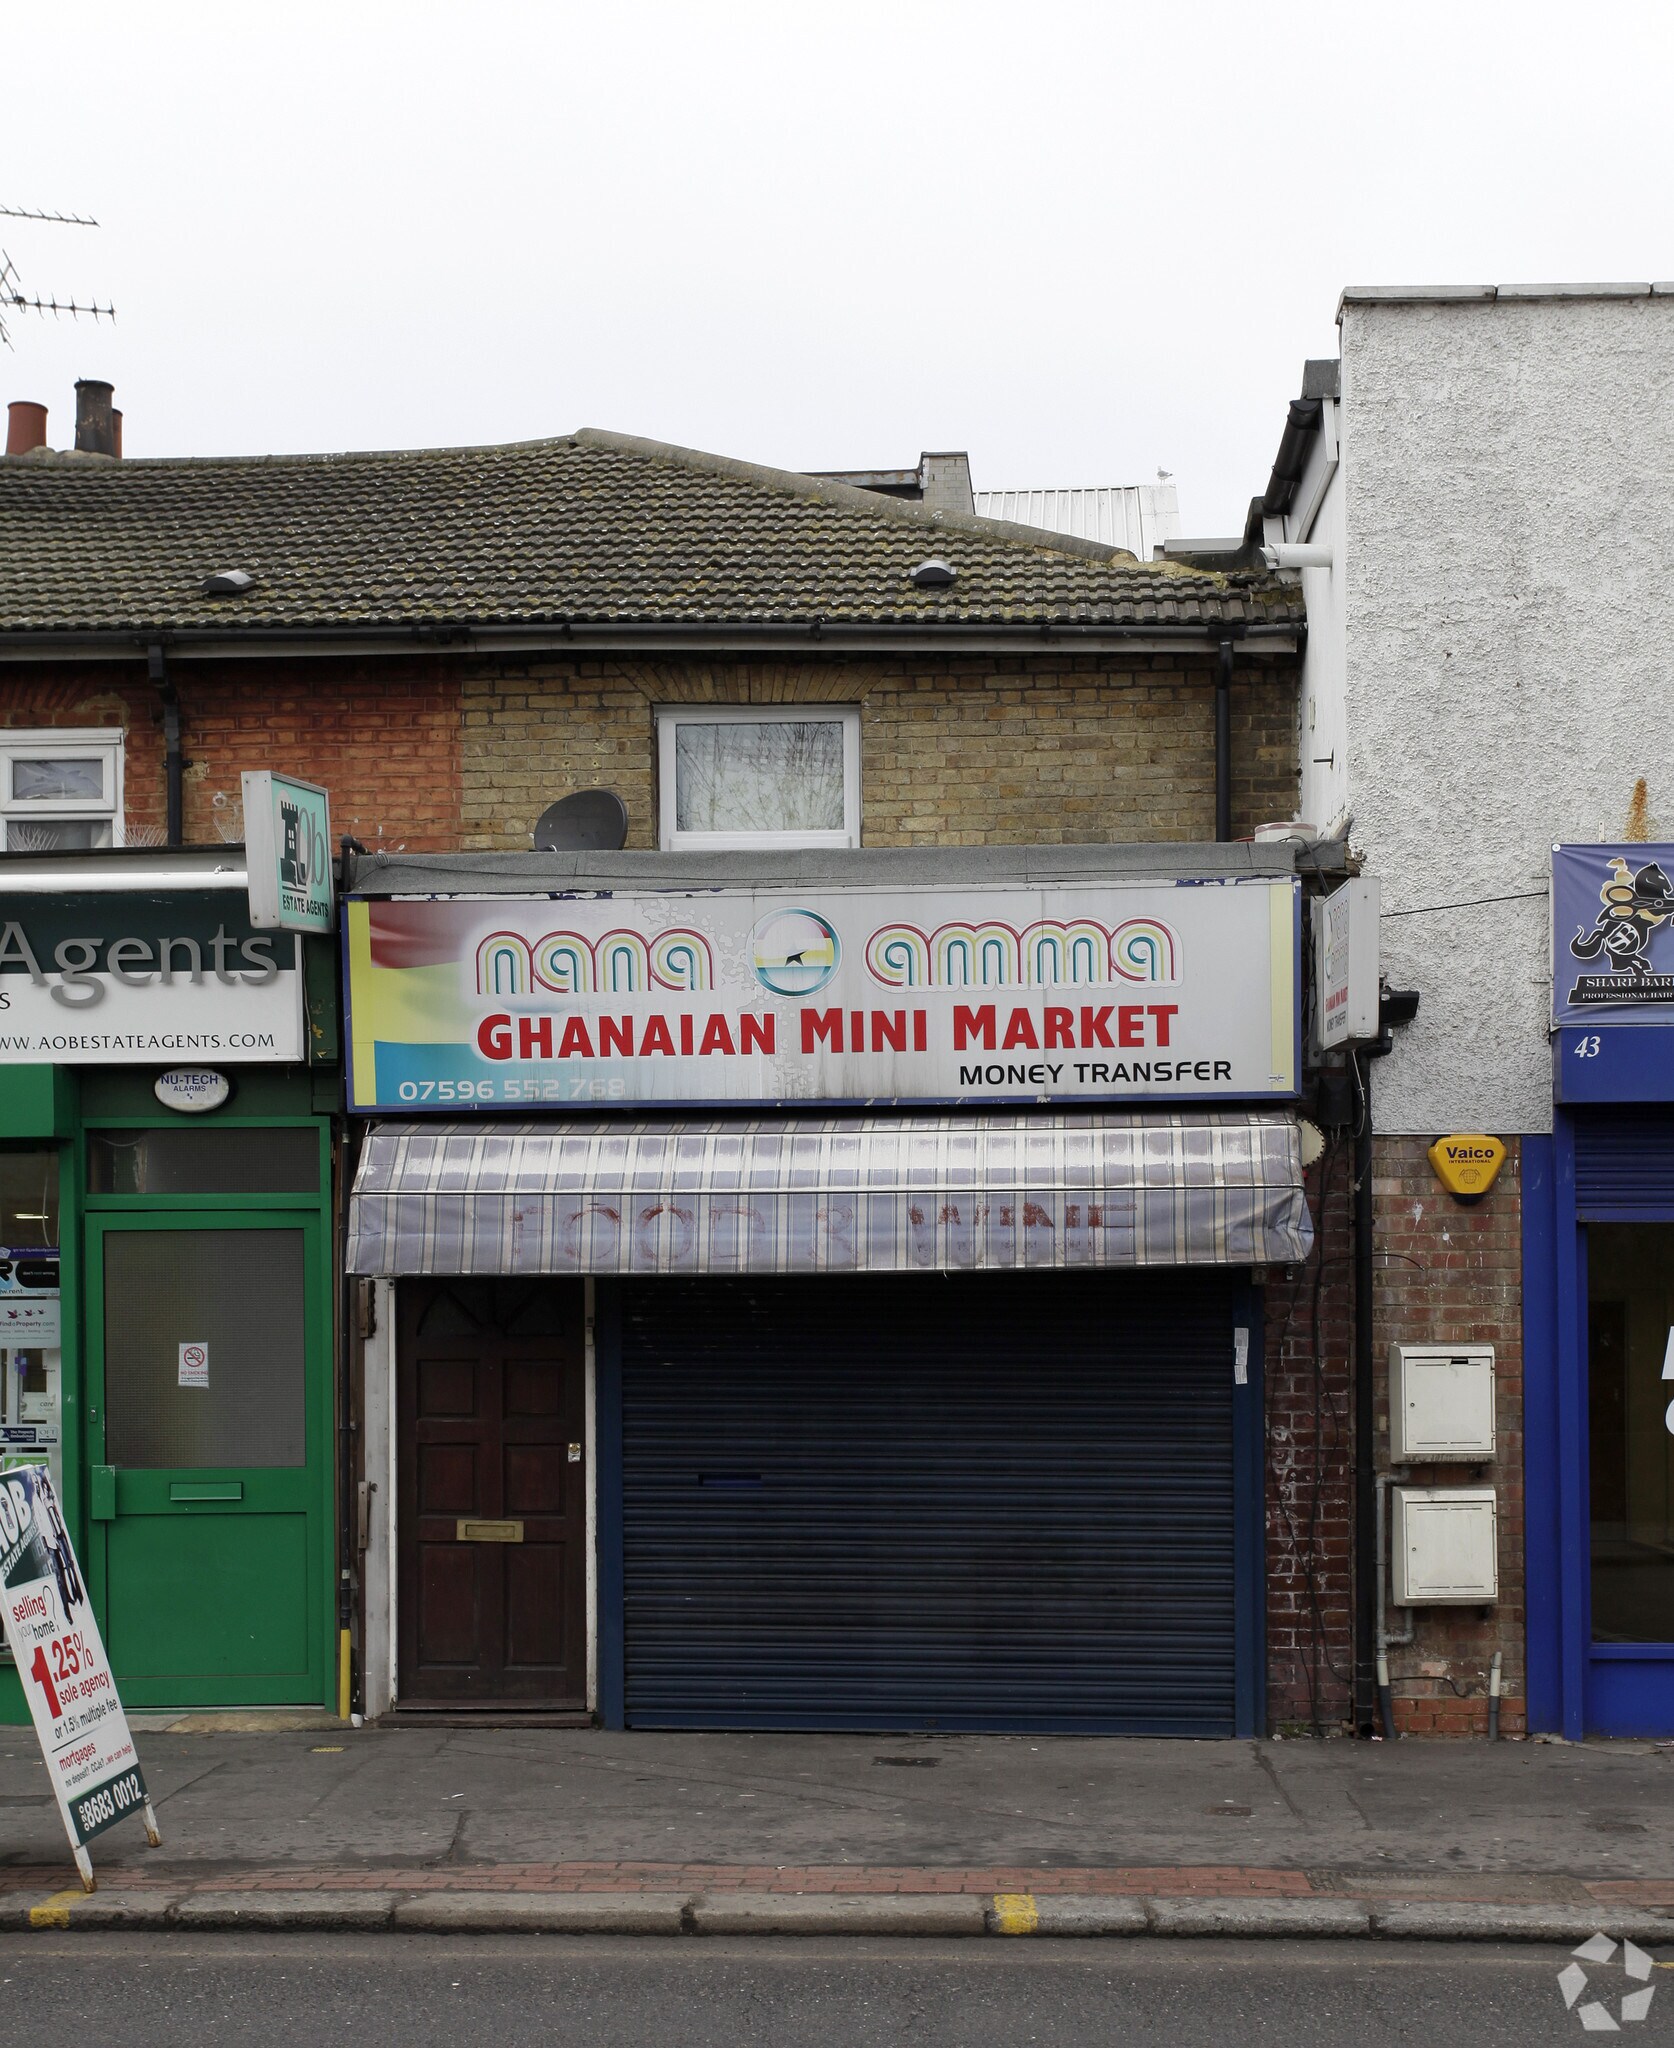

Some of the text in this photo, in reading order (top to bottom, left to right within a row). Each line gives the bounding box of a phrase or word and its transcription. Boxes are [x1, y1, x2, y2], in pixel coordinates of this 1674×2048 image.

[282, 895, 329, 918] ESTATE AGENTS
[0, 921, 278, 1009] Agents
[476, 918, 1175, 994] nana amma
[1586, 977, 1637, 987] SHARP
[477, 1004, 1178, 1060] GHANAIAN MINI MARKET
[1574, 1036, 1601, 1058] 43
[160, 1074, 218, 1086] NU-TECH
[960, 1060, 1232, 1085] MONEY TRANSFER
[399, 1078, 626, 1100] 07596 552 768
[1446, 1147, 1494, 1158] Vaico
[510, 1203, 766, 1261] FOOD
[12, 1594, 47, 1622] selling
[60, 1671, 110, 1705] sole agency
[55, 1698, 118, 1739] or 1.5% multiple fee
[59, 1742, 97, 1771] mortgages
[65, 1777, 72, 1788] no
[79, 1773, 142, 1831] 020 8683 0012
